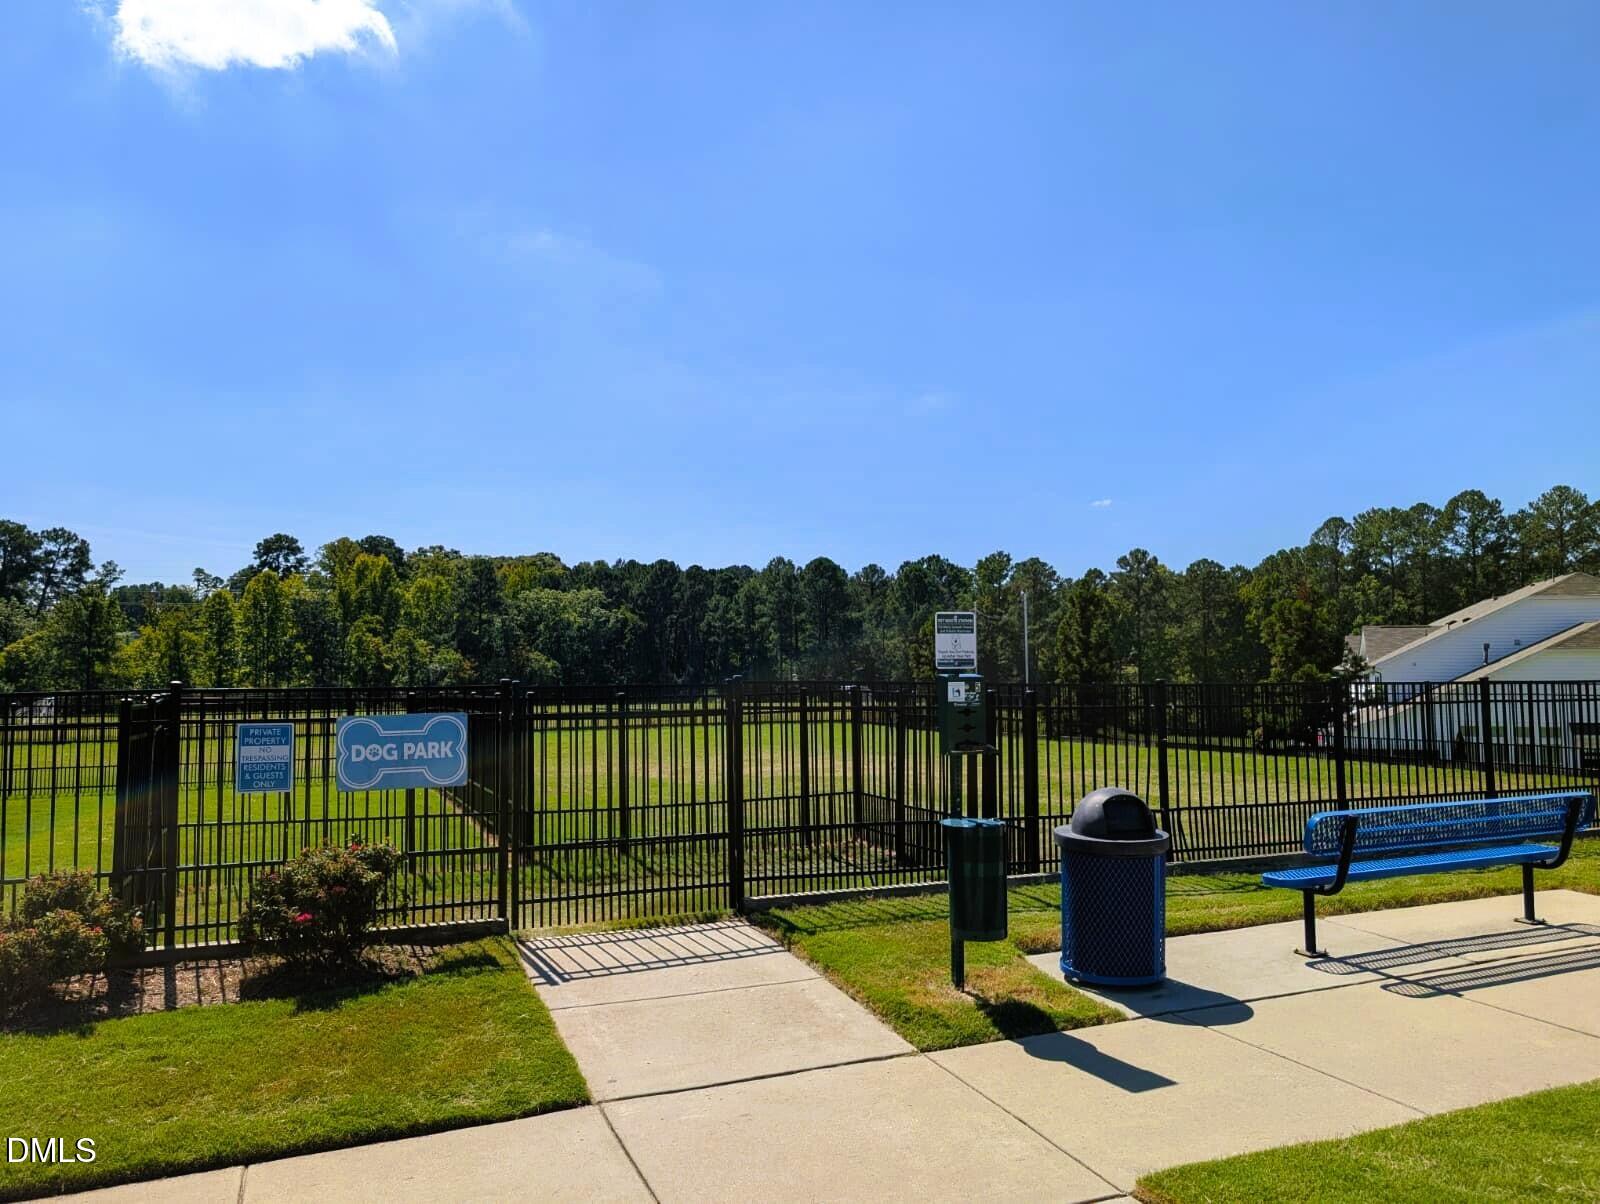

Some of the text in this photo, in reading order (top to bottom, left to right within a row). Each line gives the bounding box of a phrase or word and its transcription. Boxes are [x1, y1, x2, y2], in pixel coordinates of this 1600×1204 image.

[249, 728, 281, 736] PRIVATE
[244, 737, 287, 745] PROPERTY
[259, 746, 272, 754] NO
[351, 741, 454, 762] DOG PARK
[243, 763, 286, 771] RESIDENTS
[244, 772, 284, 780] & GUESTS
